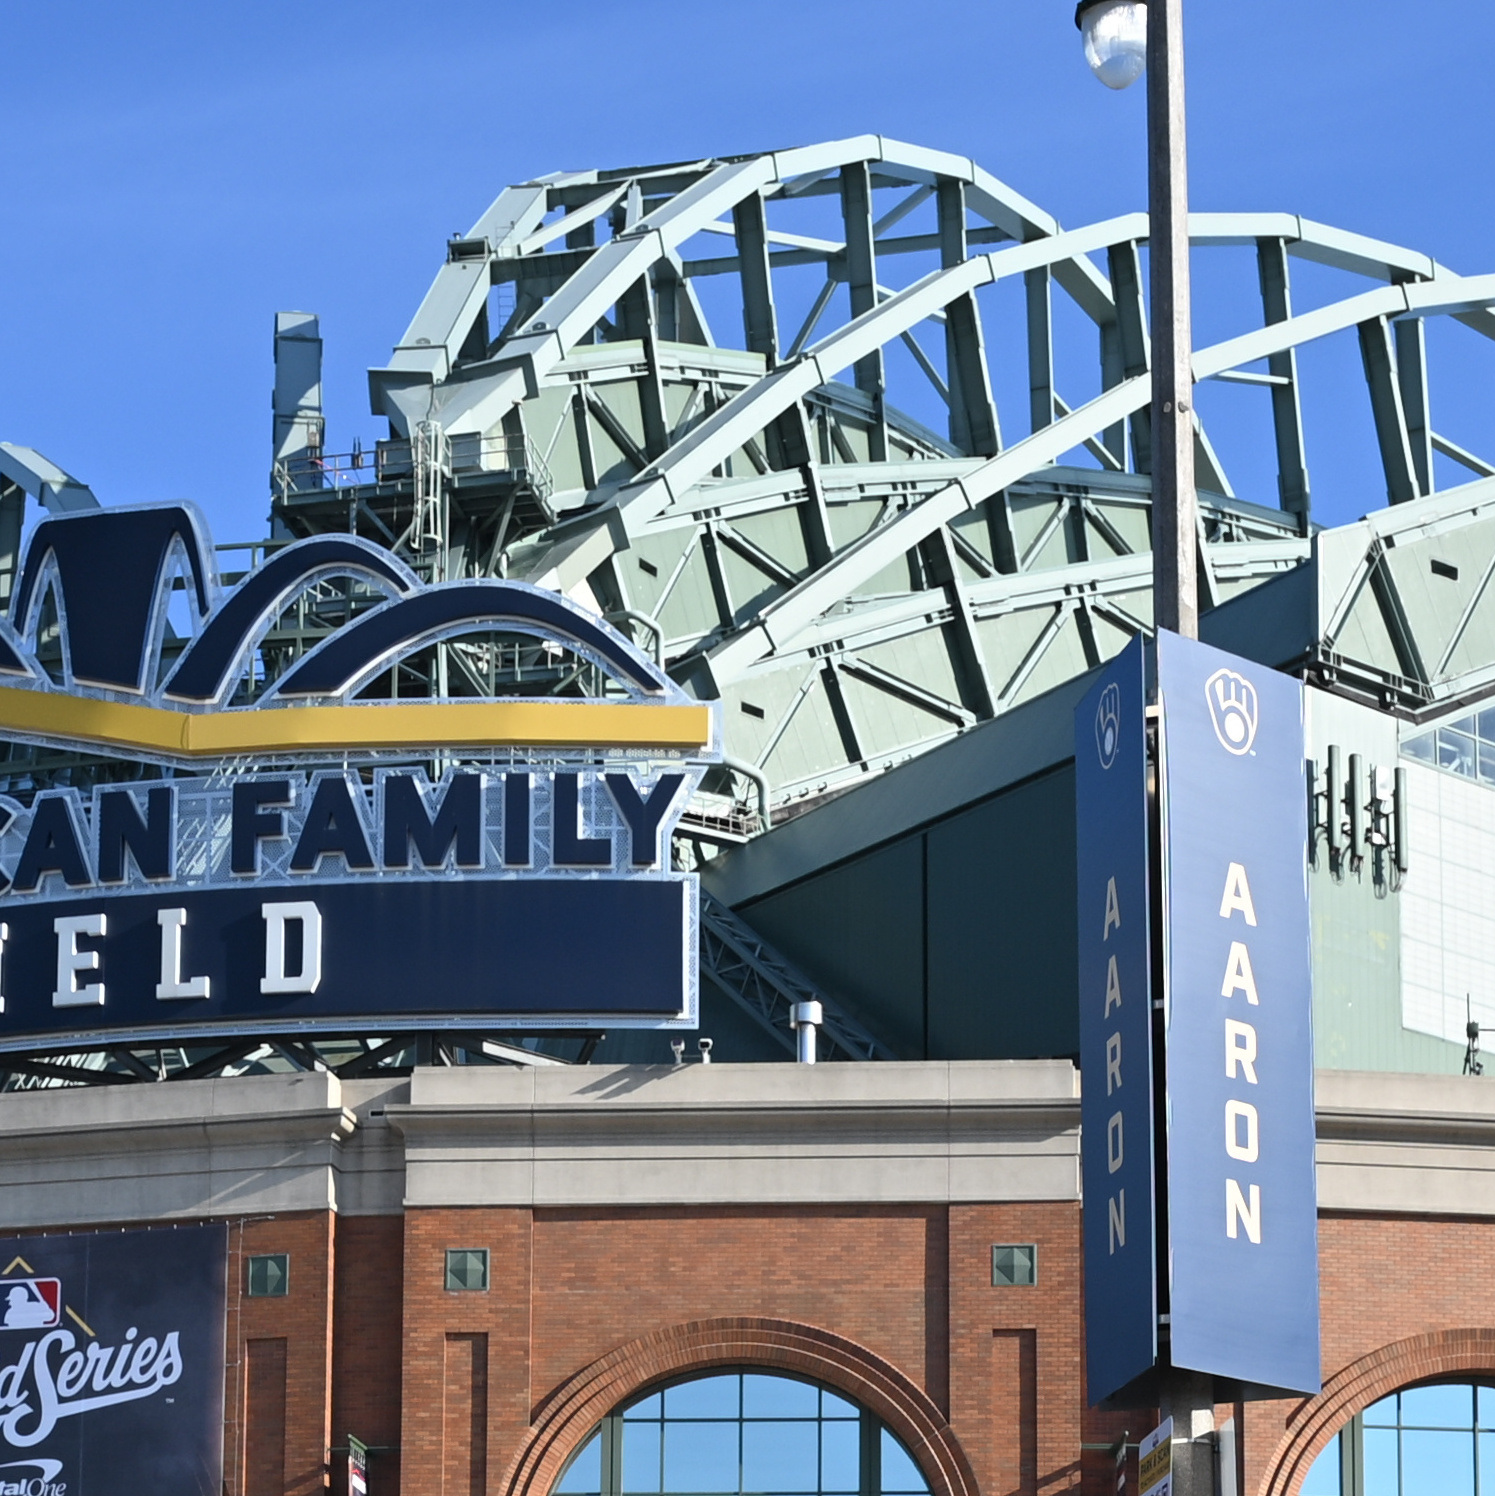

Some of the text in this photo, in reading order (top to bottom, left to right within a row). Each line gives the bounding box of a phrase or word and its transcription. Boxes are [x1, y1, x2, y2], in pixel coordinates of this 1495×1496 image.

[230, 770, 690, 877] FAMILY
[1104, 876, 1125, 1255] AARON
[1219, 862, 1261, 1244] AARON
[3, 1327, 183, 1447] Series
